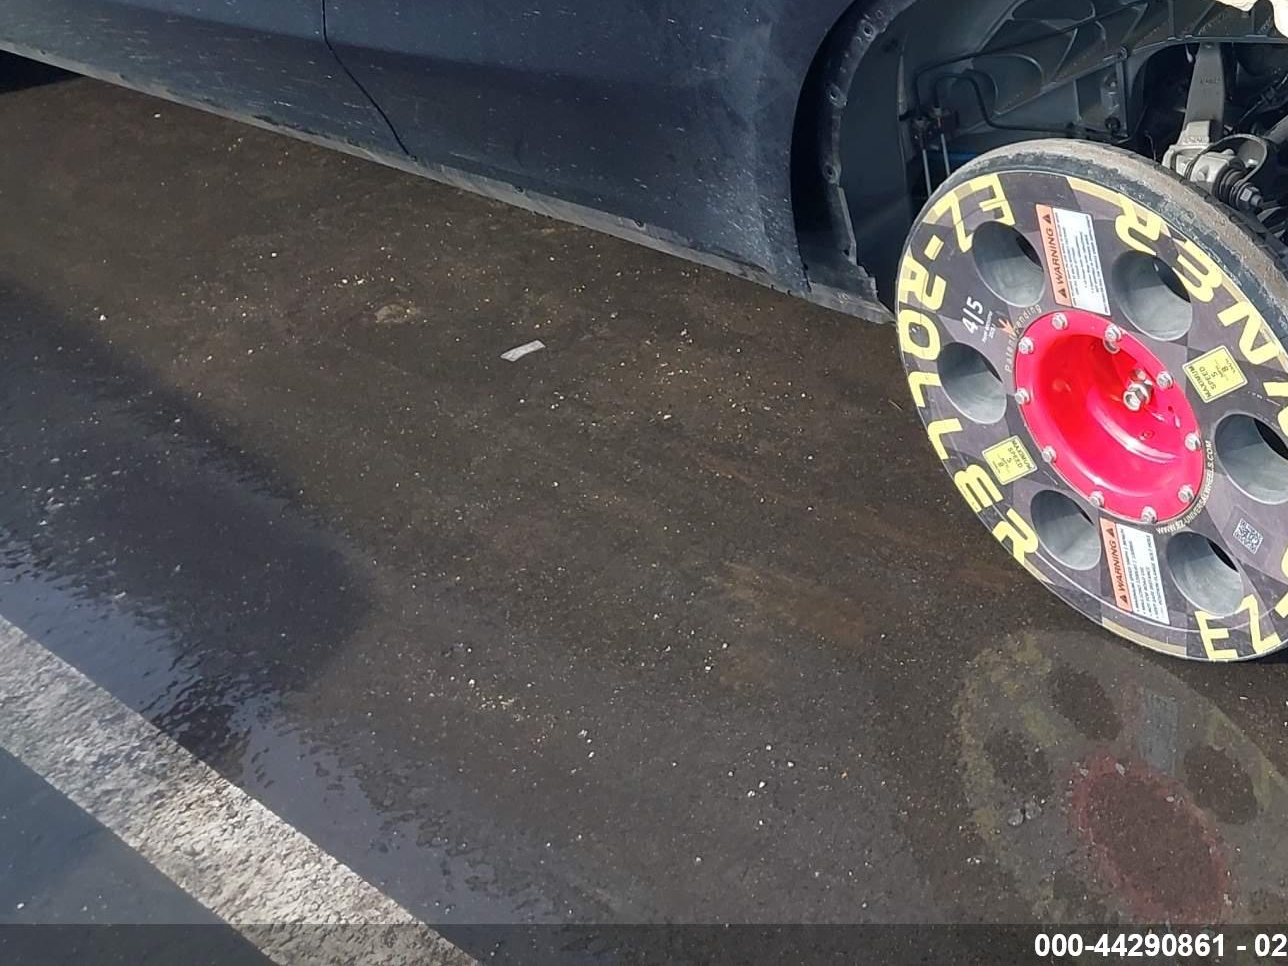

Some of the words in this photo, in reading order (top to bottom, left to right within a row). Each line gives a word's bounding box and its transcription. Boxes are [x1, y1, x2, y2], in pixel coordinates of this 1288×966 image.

[1045, 227, 1064, 285] WARNING
[1188, 365, 1212, 398] MAXIMUM
[1199, 366, 1217, 390] SPEED
[1109, 540, 1127, 592] WARNING
